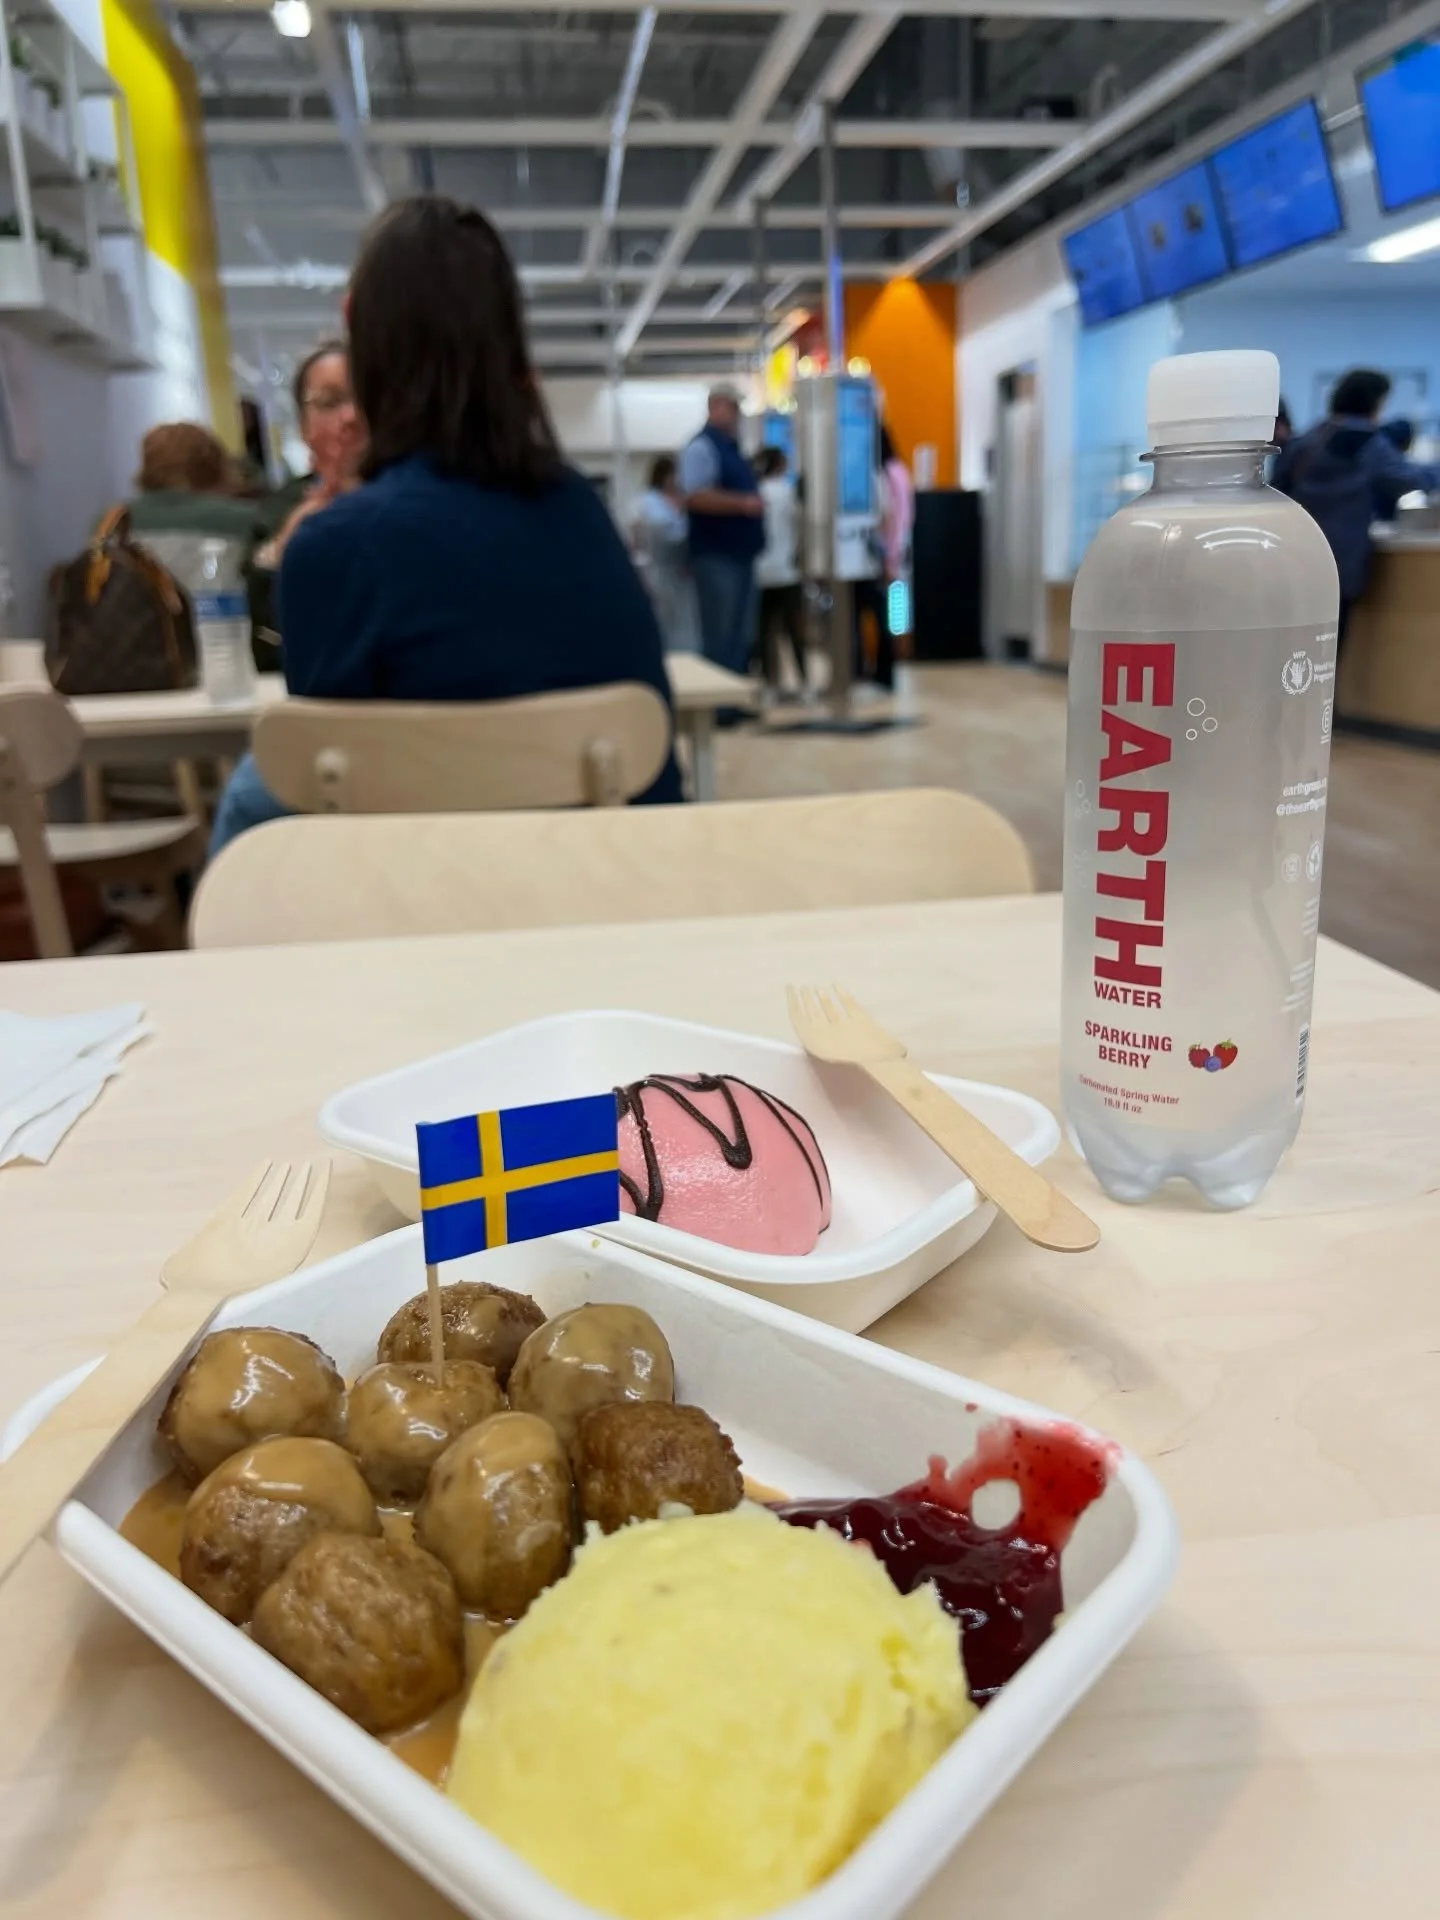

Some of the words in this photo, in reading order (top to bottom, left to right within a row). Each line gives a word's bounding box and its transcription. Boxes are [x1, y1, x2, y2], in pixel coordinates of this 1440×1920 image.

[1094, 643, 1176, 987] EARTH
[1094, 980, 1162, 1009] WATER
[1085, 1020, 1172, 1052] SPARKLING
[1098, 1044, 1151, 1069] BERRY
[1120, 1088, 1149, 1103] Spring
[1152, 1093, 1180, 1105] Water
[1131, 1105, 1143, 1114] oz
